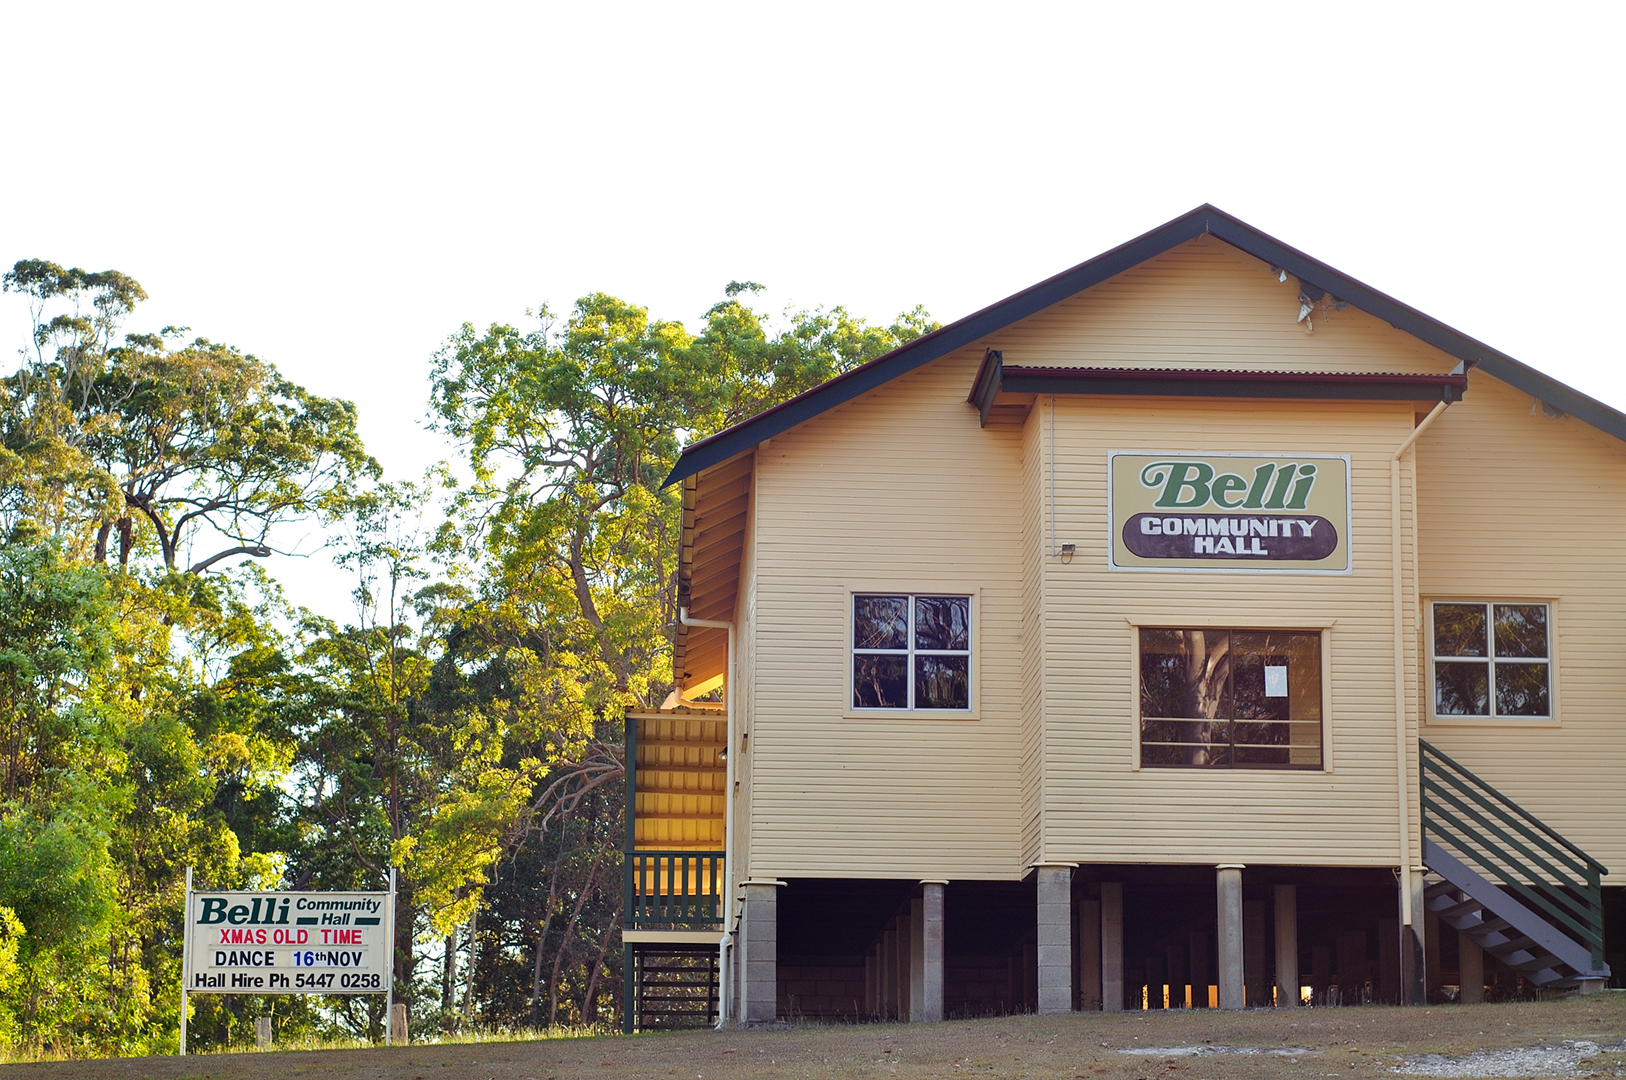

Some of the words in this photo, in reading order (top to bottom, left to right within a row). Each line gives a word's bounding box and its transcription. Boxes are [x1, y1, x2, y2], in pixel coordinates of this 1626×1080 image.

[1140, 461, 1318, 510] Belli
[1140, 517, 1319, 537] COMMUNITY
[1194, 536, 1268, 555] HALL
[197, 898, 290, 925] Belli
[296, 898, 381, 913] Community
[321, 913, 351, 926] Hall
[220, 929, 267, 944] XMAS
[273, 929, 309, 944] OLD
[320, 929, 363, 944] TIME
[215, 951, 275, 966] DANCE
[195, 973, 226, 988] Hall
[231, 973, 264, 988] Hire
[269, 973, 290, 988] Ph
[295, 973, 335, 988] 5447
[340, 973, 381, 988] 0258
